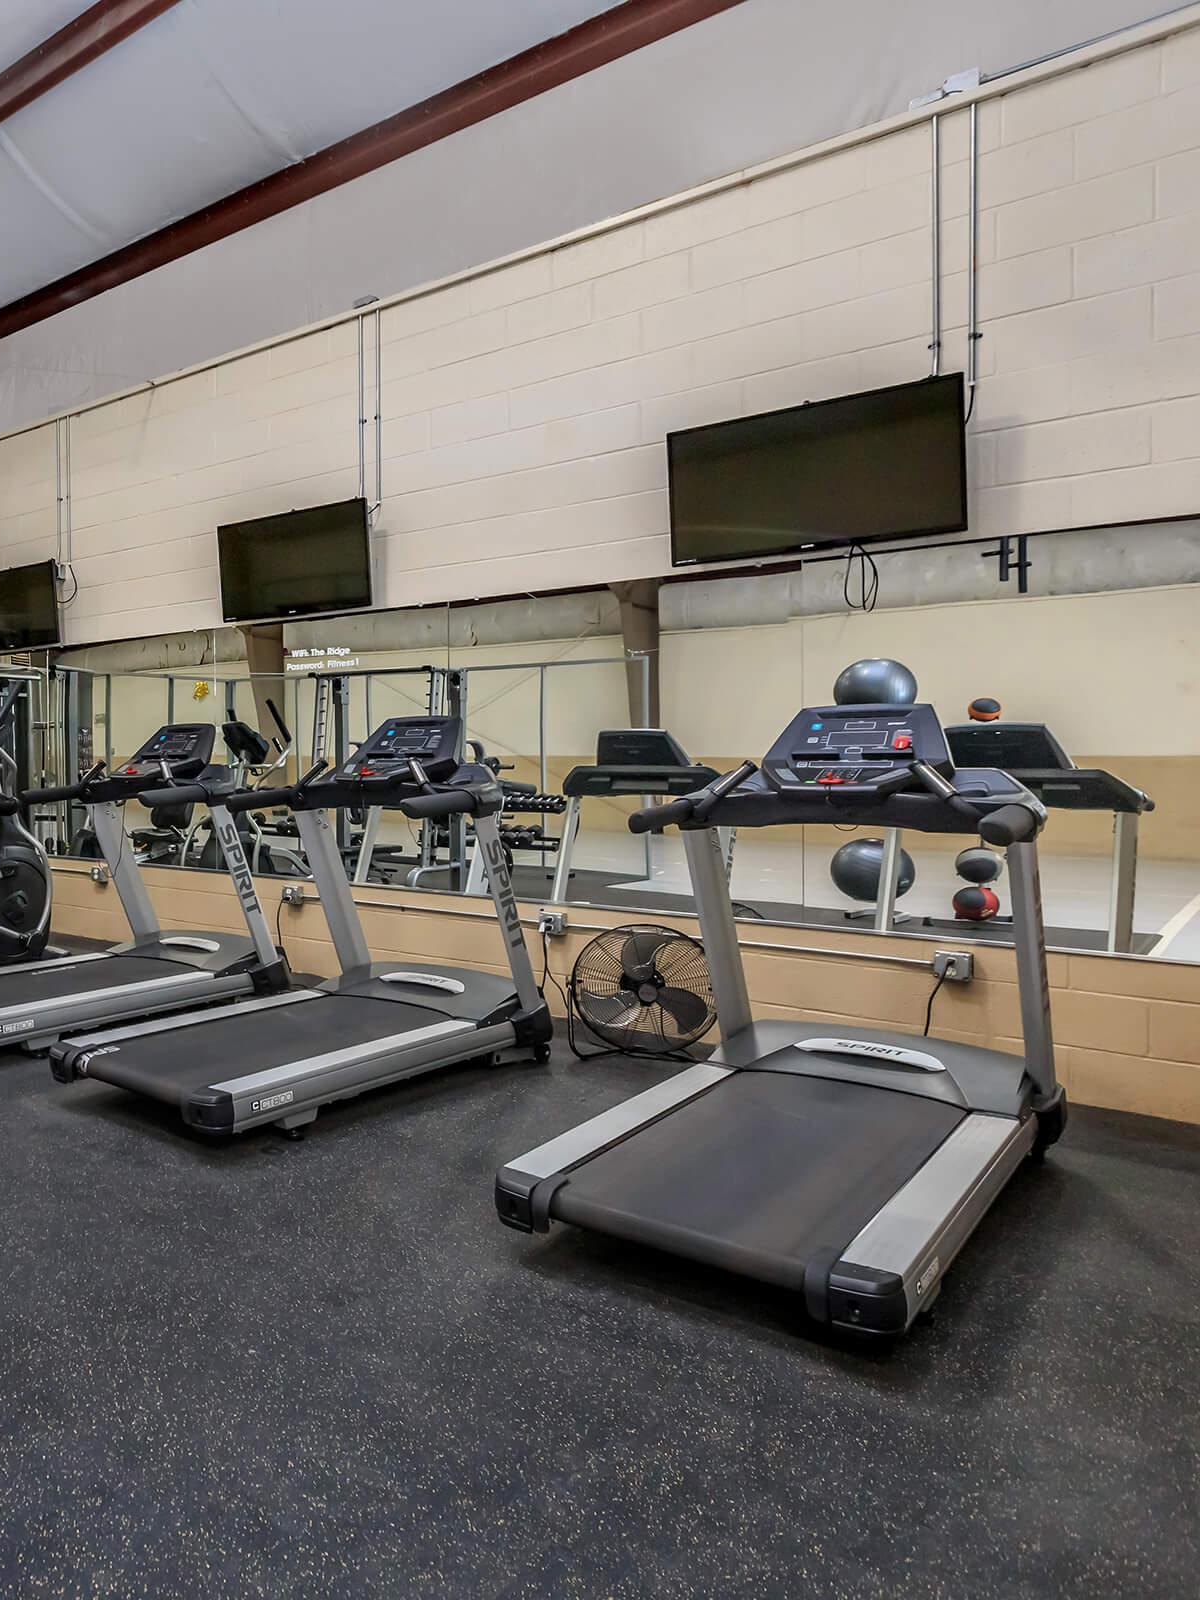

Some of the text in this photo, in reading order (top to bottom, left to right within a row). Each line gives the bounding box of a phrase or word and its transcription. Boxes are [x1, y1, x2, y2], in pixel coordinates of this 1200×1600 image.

[310, 648, 326, 657] The
[326, 646, 351, 657] Ridge
[219, 823, 262, 915] SPIRIT
[486, 839, 527, 951] SPIRIT
[834, 1041, 906, 1057] SPIRIT
